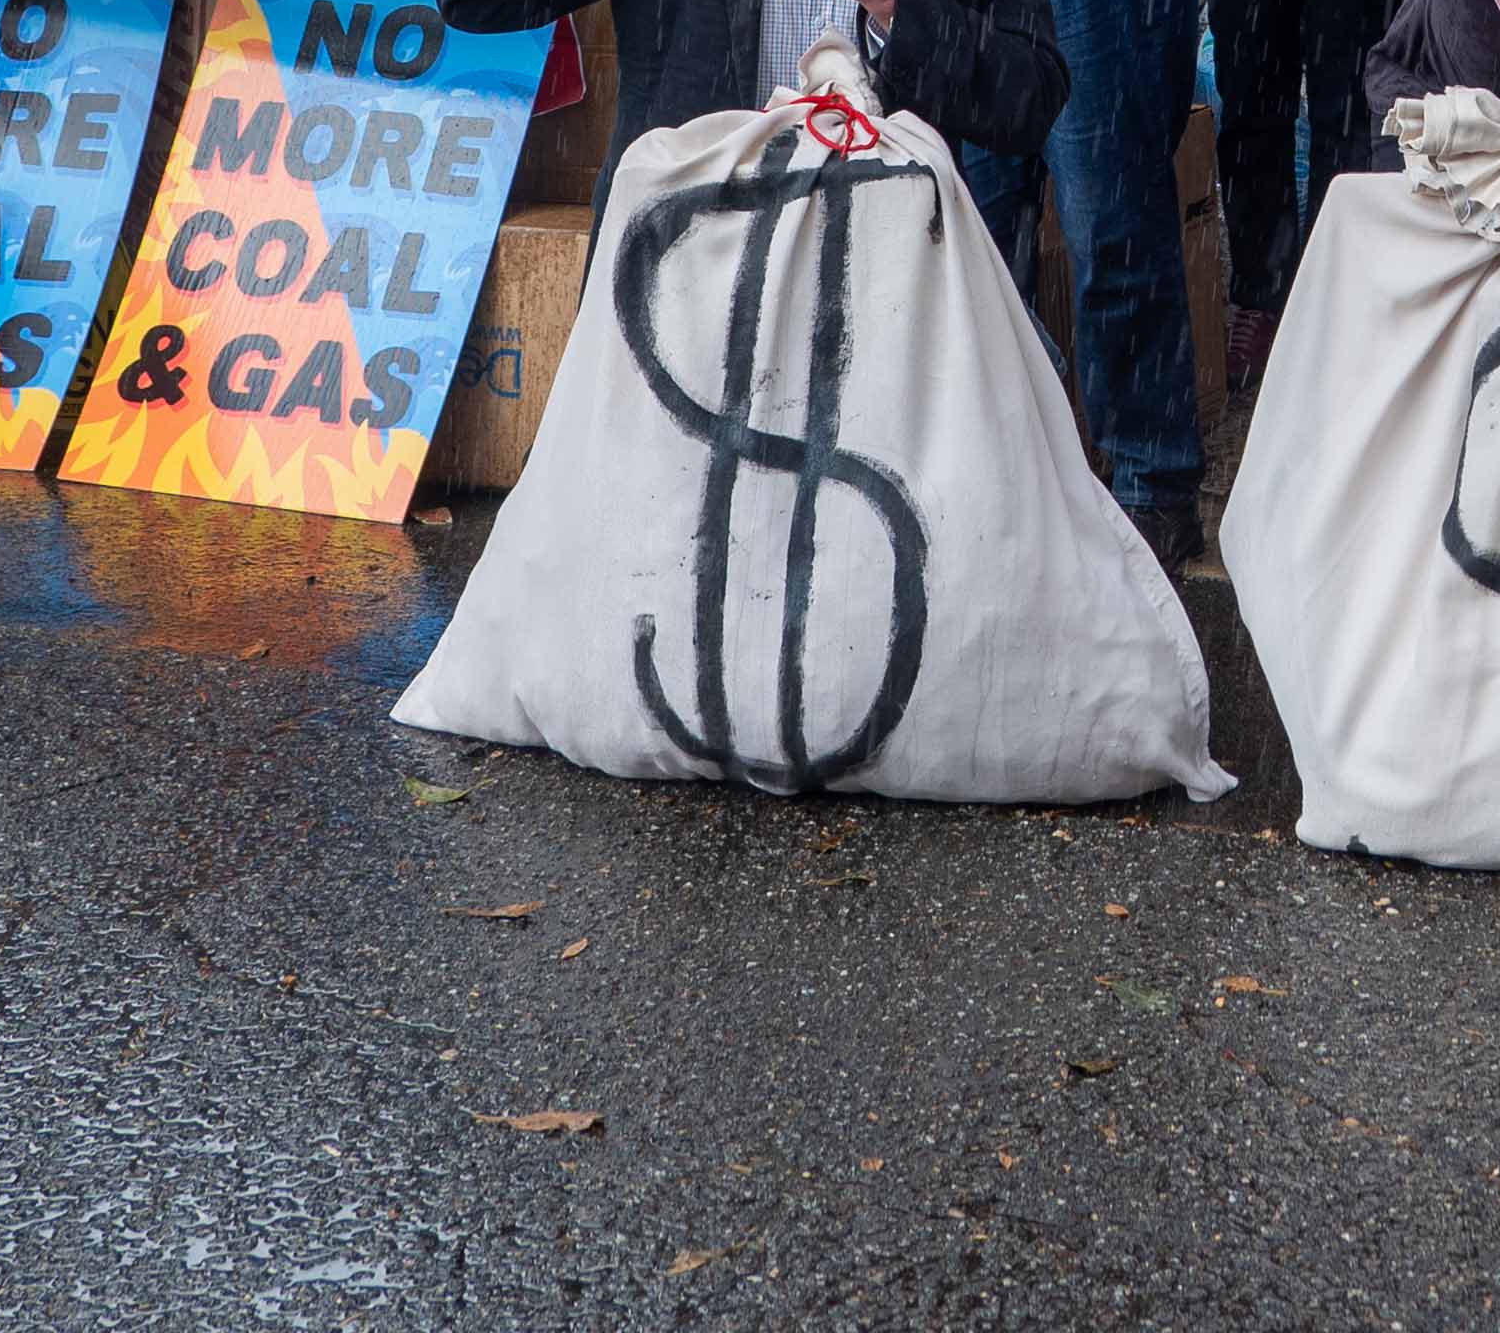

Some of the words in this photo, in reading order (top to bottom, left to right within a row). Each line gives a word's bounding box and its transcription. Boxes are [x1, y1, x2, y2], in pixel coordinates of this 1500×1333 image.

[298, 0, 447, 81] NO
[191, 97, 496, 200] MORE
[166, 209, 442, 315] COAL
[116, 324, 186, 407] &
[206, 334, 423, 431] GAS
